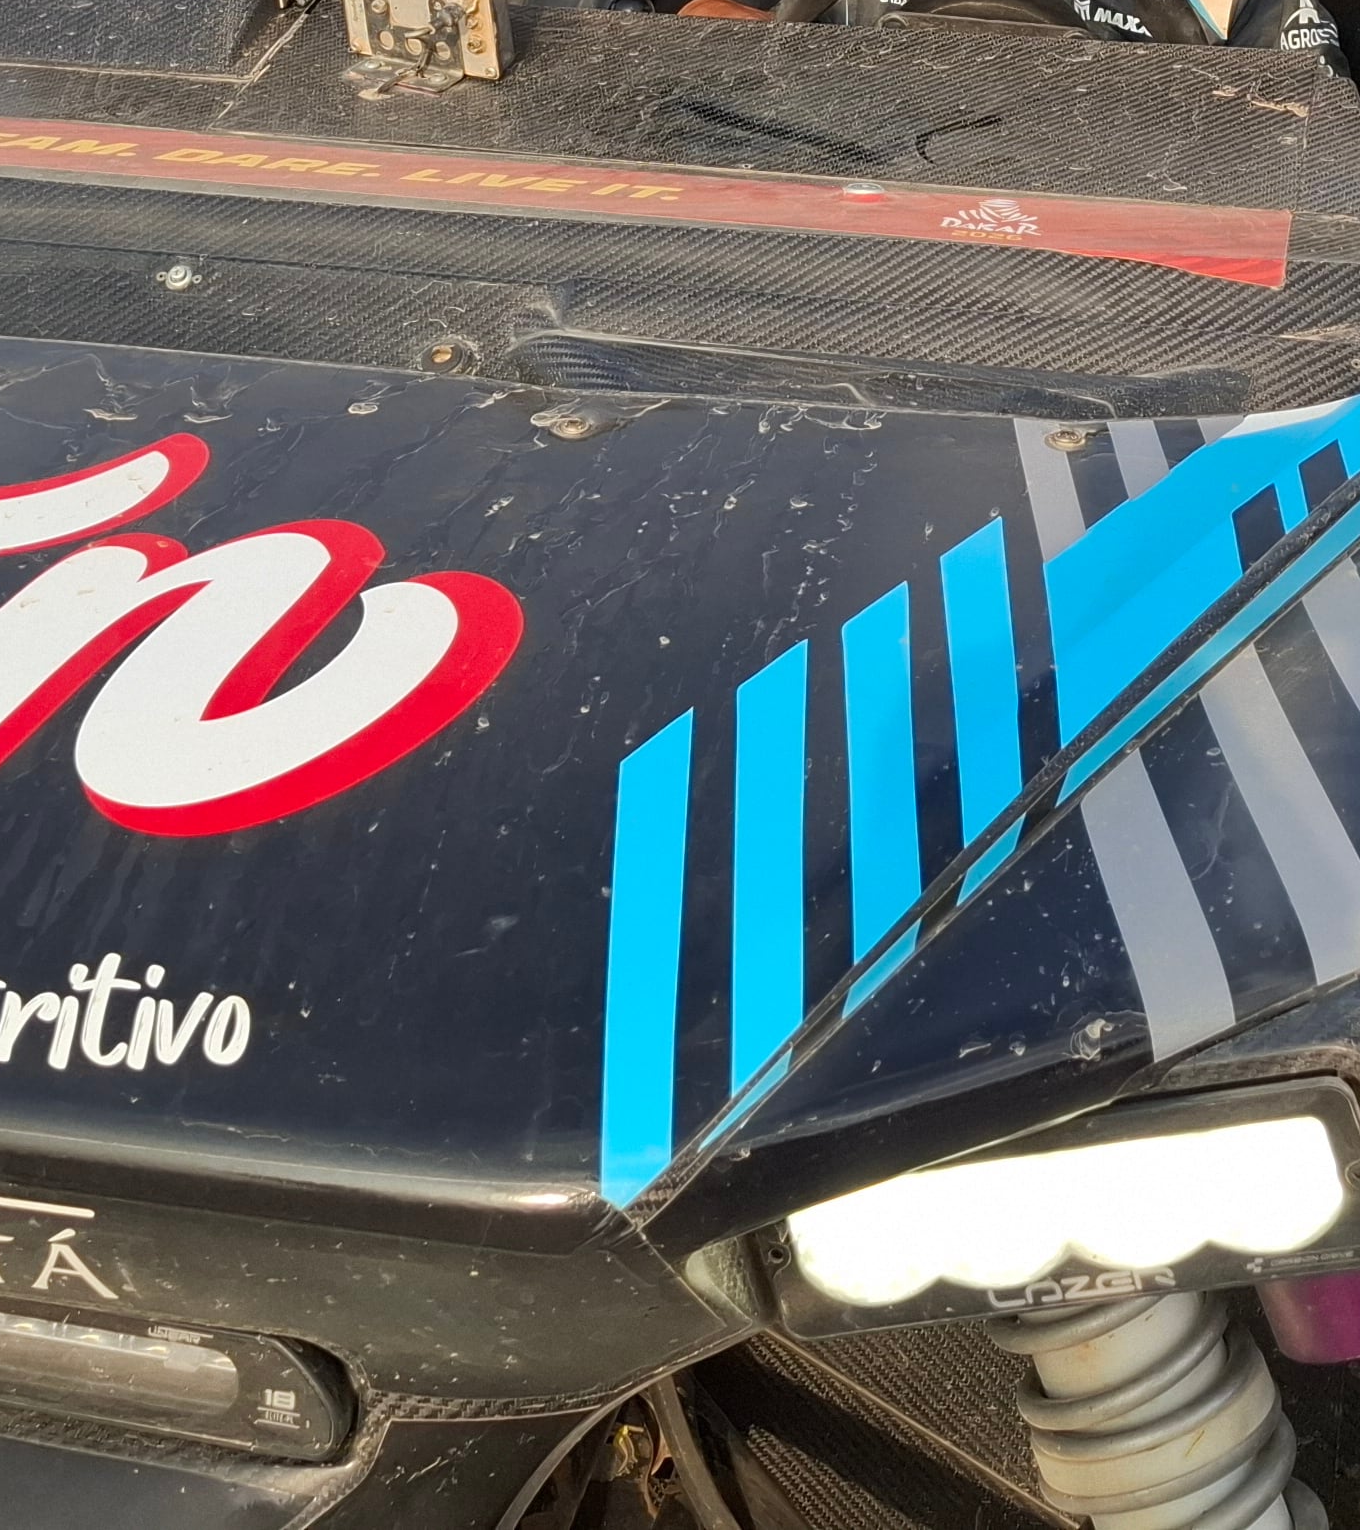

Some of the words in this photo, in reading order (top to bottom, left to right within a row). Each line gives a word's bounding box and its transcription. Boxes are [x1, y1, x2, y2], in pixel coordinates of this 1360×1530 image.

[152, 146, 383, 179] DARE.
[397, 167, 590, 196] LIVE
[590, 181, 685, 202] IT.
[938, 216, 1043, 238] DAKAR
[264, 1387, 296, 1411] 18
